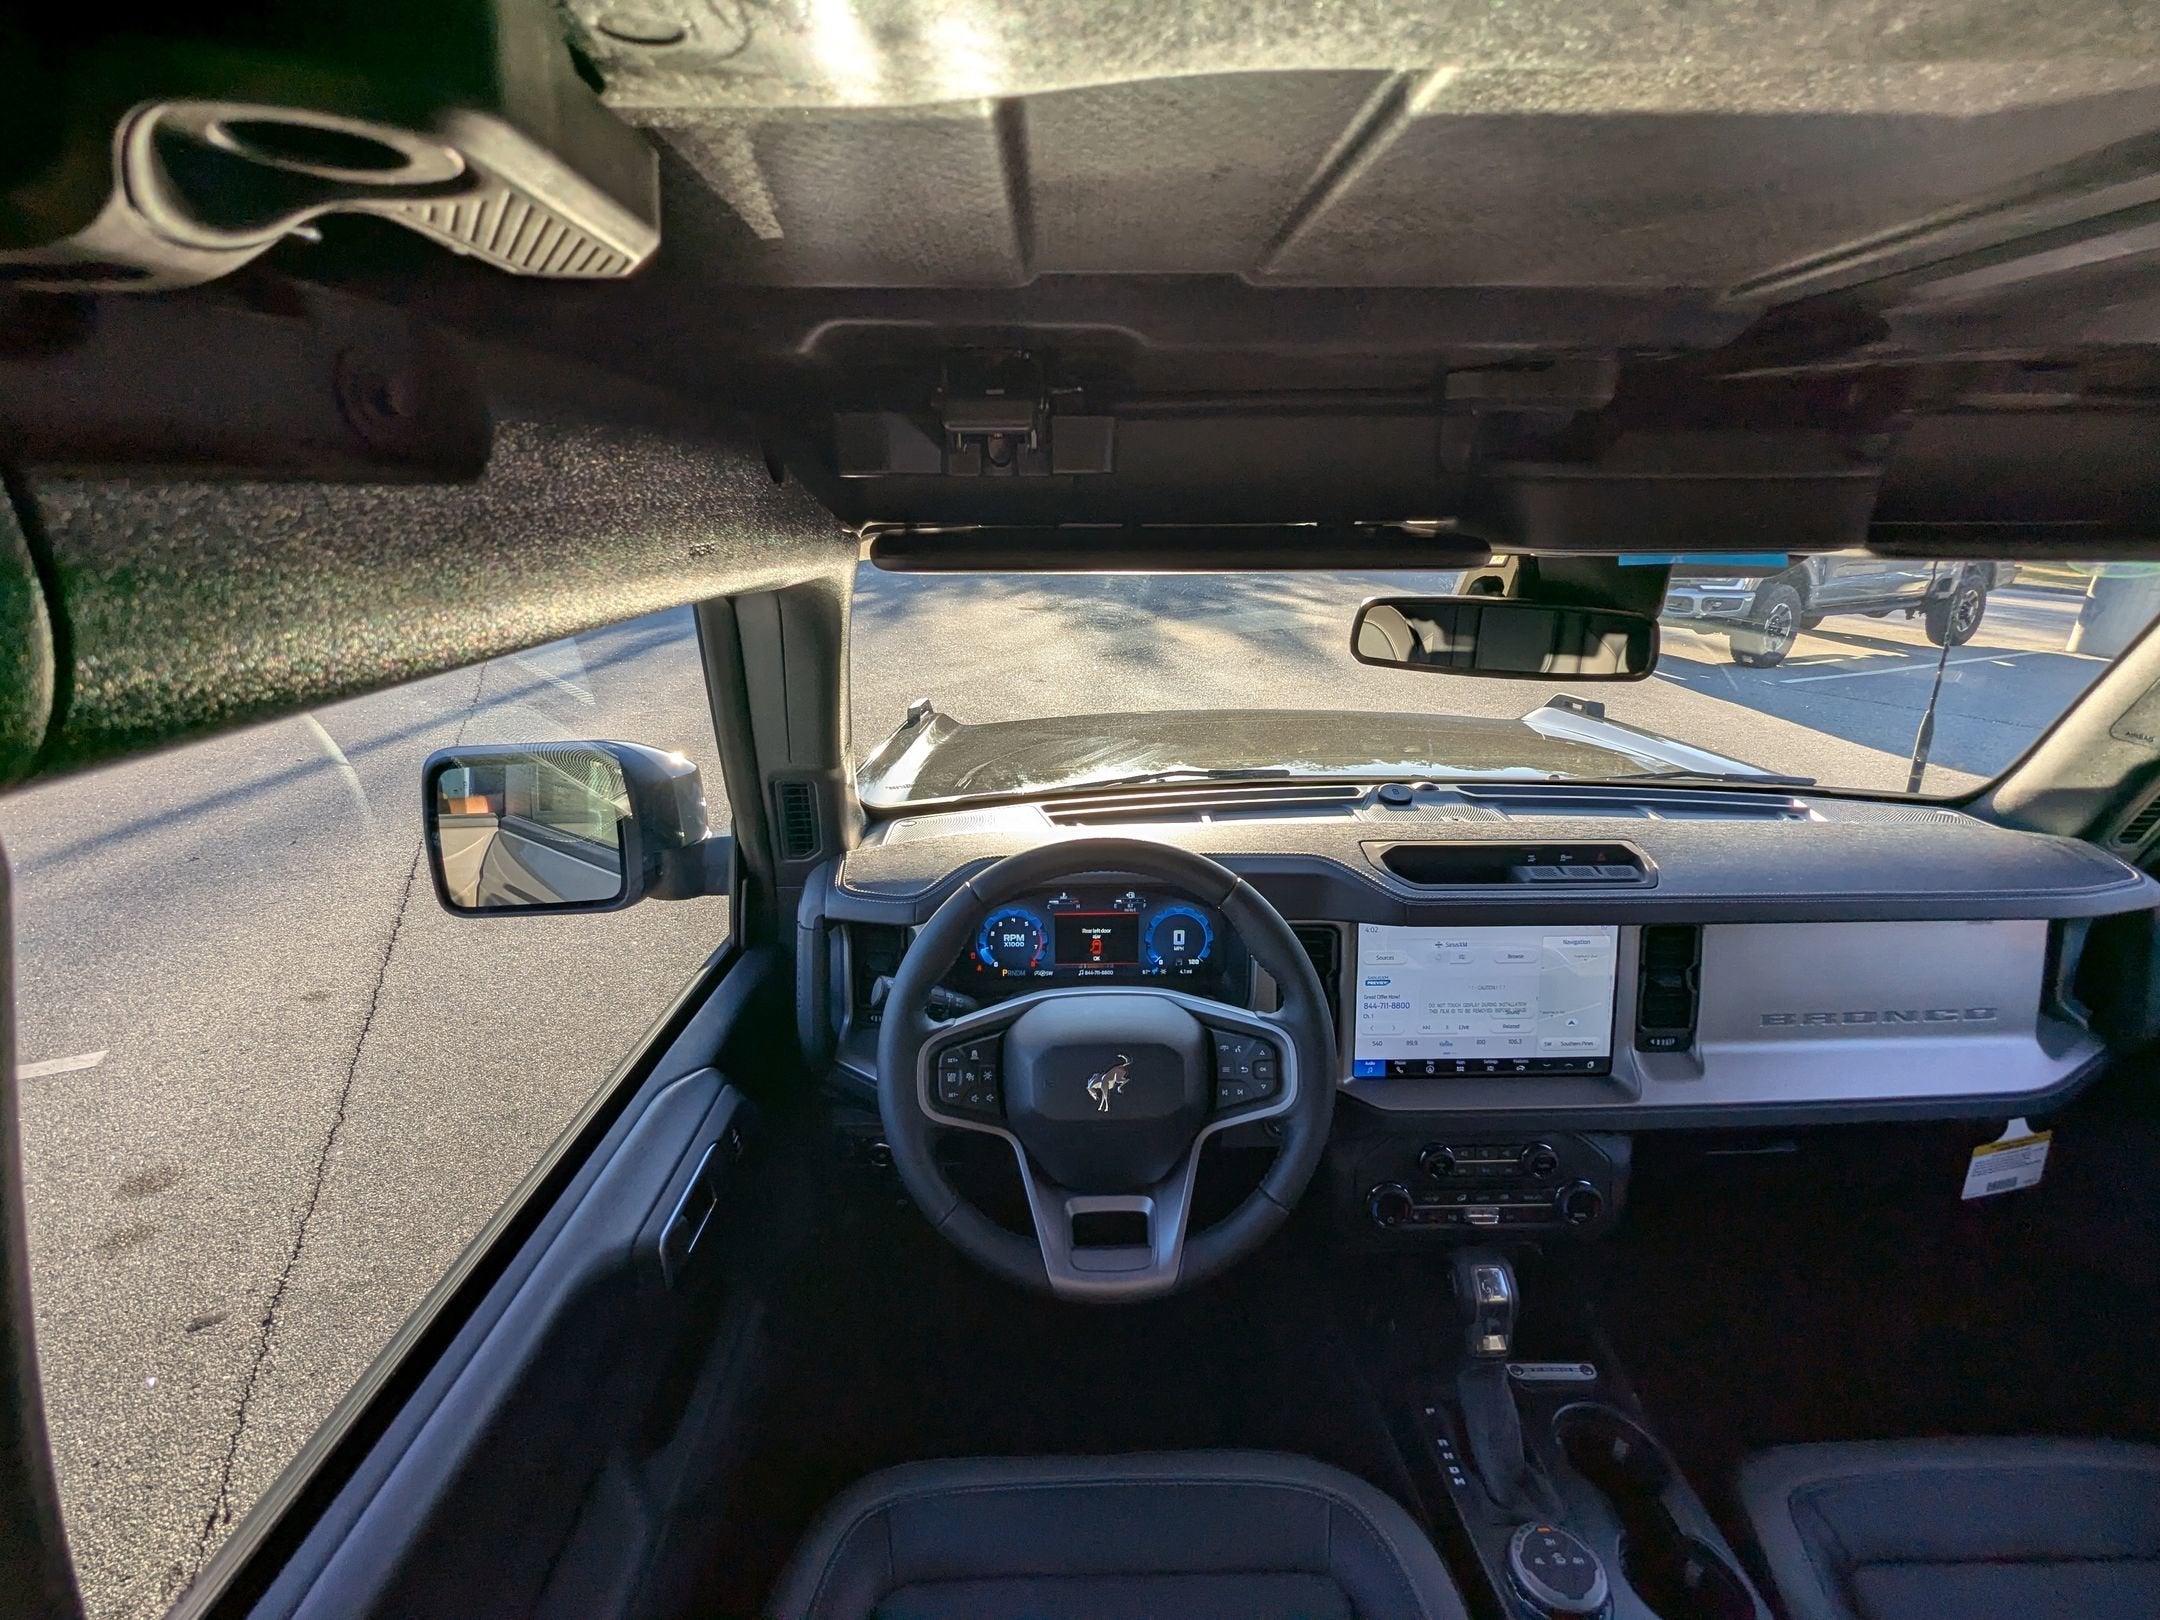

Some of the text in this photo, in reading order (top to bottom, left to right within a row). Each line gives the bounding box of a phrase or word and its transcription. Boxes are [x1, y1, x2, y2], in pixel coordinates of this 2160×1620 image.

[1173, 930, 1185, 945] 0
[1363, 1002, 1410, 1010] 844-711-8800
[1760, 1008, 1998, 1027] BRONCO
[1448, 1466, 1460, 1474] D
[1453, 1477, 1466, 1485] M
